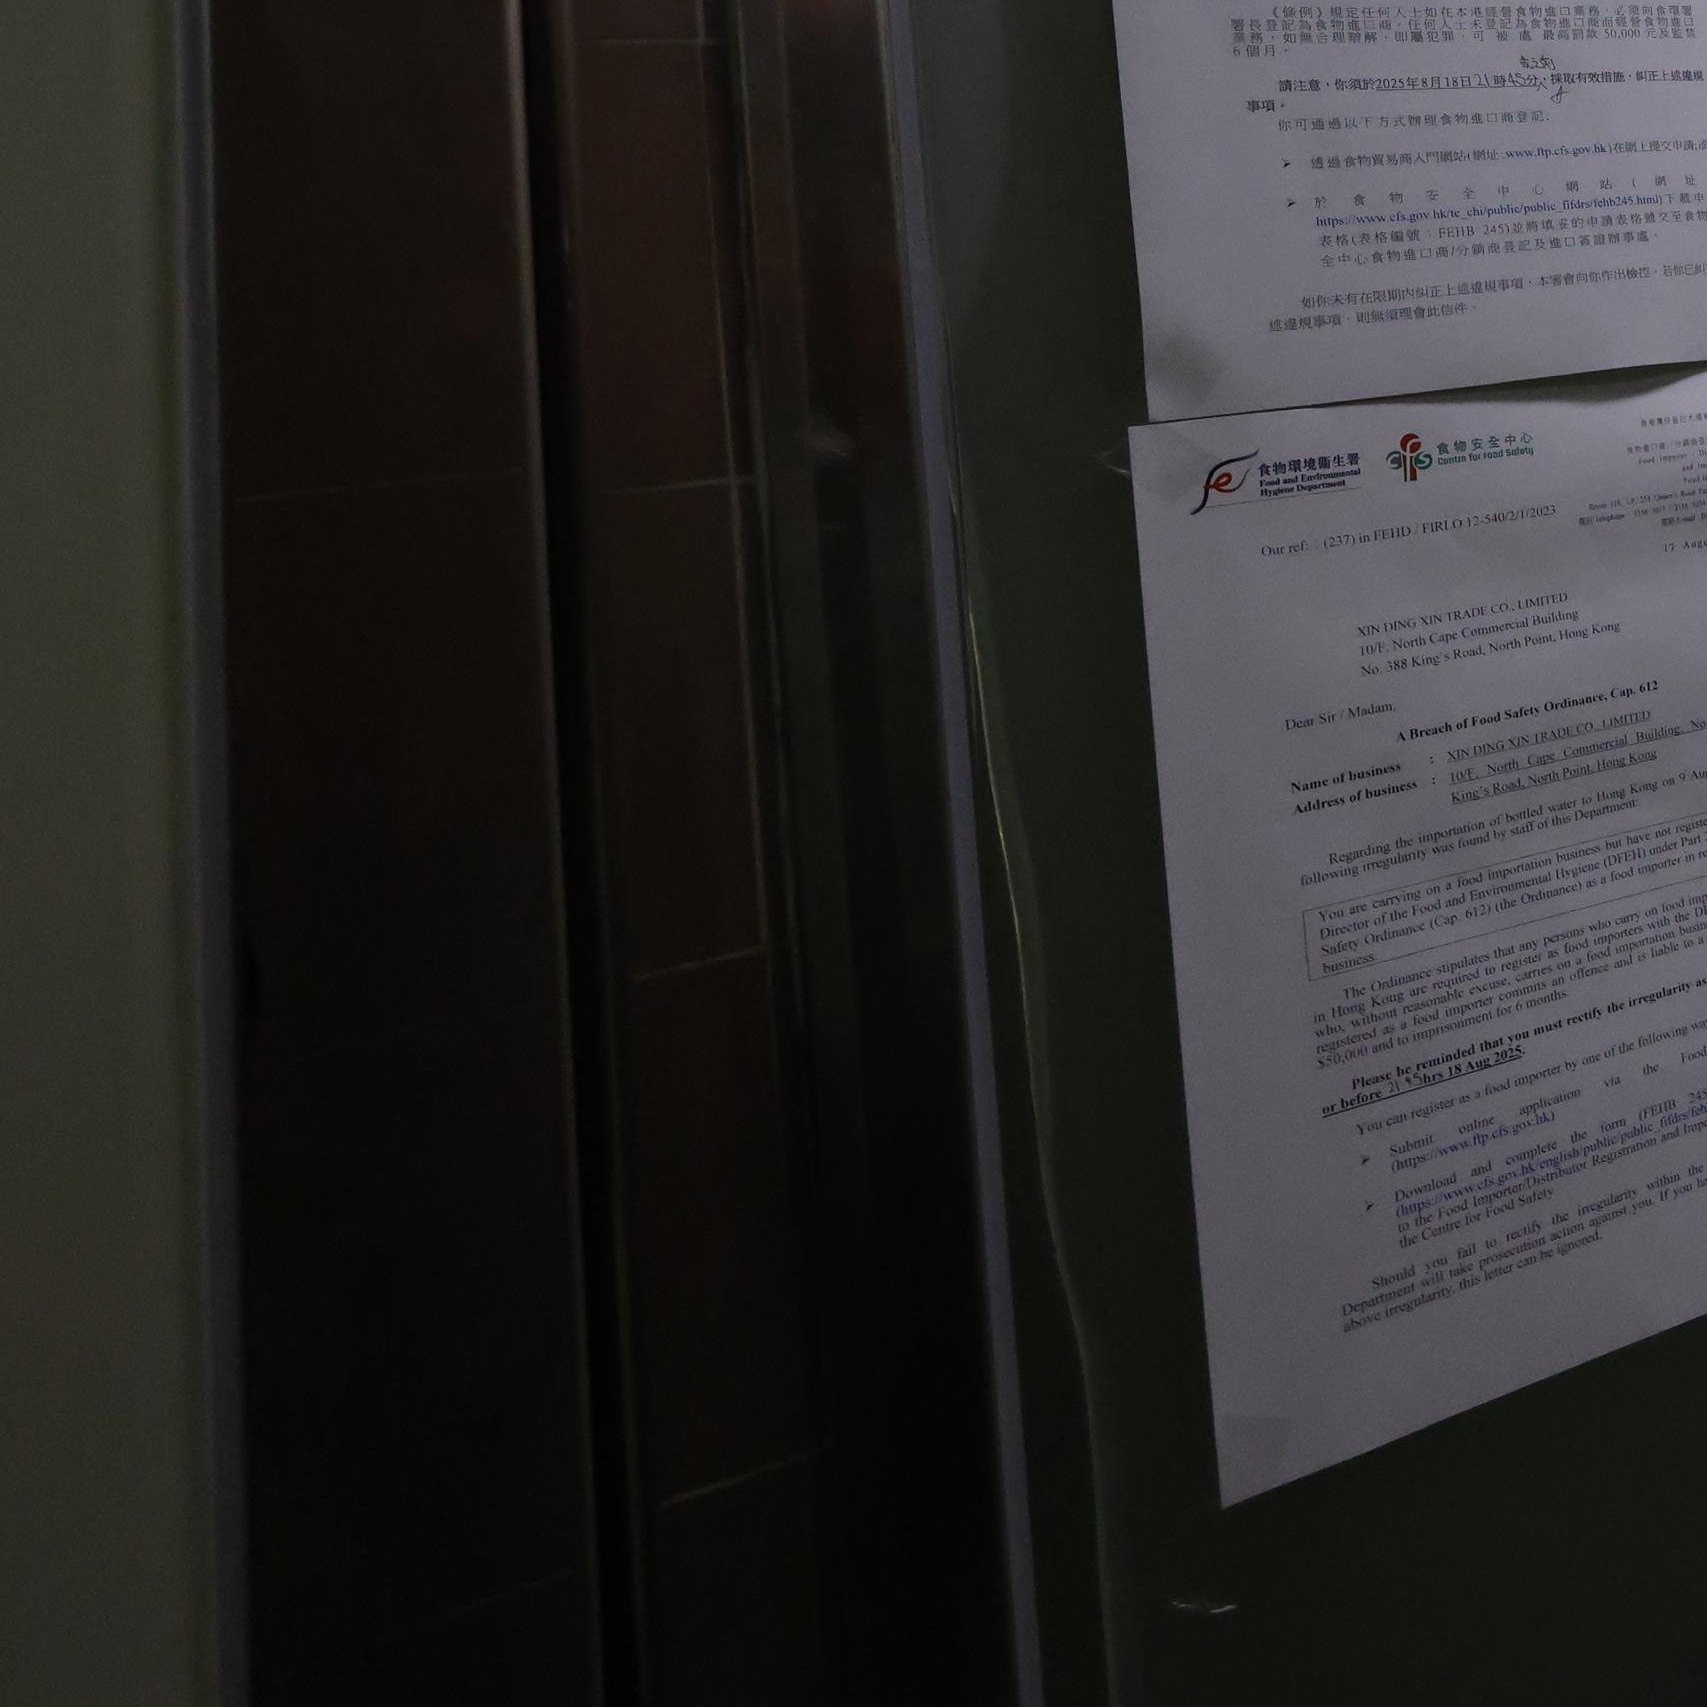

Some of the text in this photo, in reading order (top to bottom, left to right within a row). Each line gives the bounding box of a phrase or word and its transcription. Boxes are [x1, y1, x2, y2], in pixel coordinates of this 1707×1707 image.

[1434, 430, 1534, 456] 食物安全中心
[1258, 466, 1362, 488] Food and Environmental
[1356, 623, 1381, 637] XIN
[1382, 616, 1417, 633] DING
[1417, 612, 1443, 627] XIN
[1444, 604, 1487, 622] TRADE
[1516, 591, 1568, 610] LIMITED
[1390, 633, 1427, 652] North
[1427, 631, 1458, 645] Cape
[1459, 615, 1530, 639] Commercial
[1531, 609, 1580, 627] Building
[1359, 621, 1620, 677] No. 388 King's Road, North Point, Hong Kong
[1283, 715, 1317, 733] Dear
[1315, 709, 1338, 725] Sir
[1345, 699, 1397, 721] Madam,
[1395, 678, 1659, 743] A Breach of Food Safety Ordinance, Cap. 612
[1289, 762, 1402, 795] Name of business
[1292, 780, 1418, 815] Address of business
[1327, 842, 1392, 866] Regarding
[1394, 835, 1414, 850] the
[1417, 820, 1486, 844] importation
[1487, 812, 1503, 827] of
[1503, 803, 1544, 824] bottled
[1546, 798, 1578, 813] water
[1580, 795, 1593, 806] to
[1595, 787, 1626, 803] Hong
[1628, 780, 1659, 795] Kong
[1660, 776, 1676, 787] on
[1677, 771, 1687, 781] 9
[1350, 1070, 1396, 1091] Please
[1393, 1064, 1412, 1081] be
[1409, 1042, 1477, 1076] reminded
[1478, 1035, 1504, 1053] that
[1505, 1029, 1530, 1047] you
[1532, 1018, 1563, 1037] must
[1565, 1005, 1602, 1026] rectify
[1605, 1000, 1626, 1014] the
[1626, 980, 1692, 1008] irregularity
[1694, 976, 1707, 988] as
